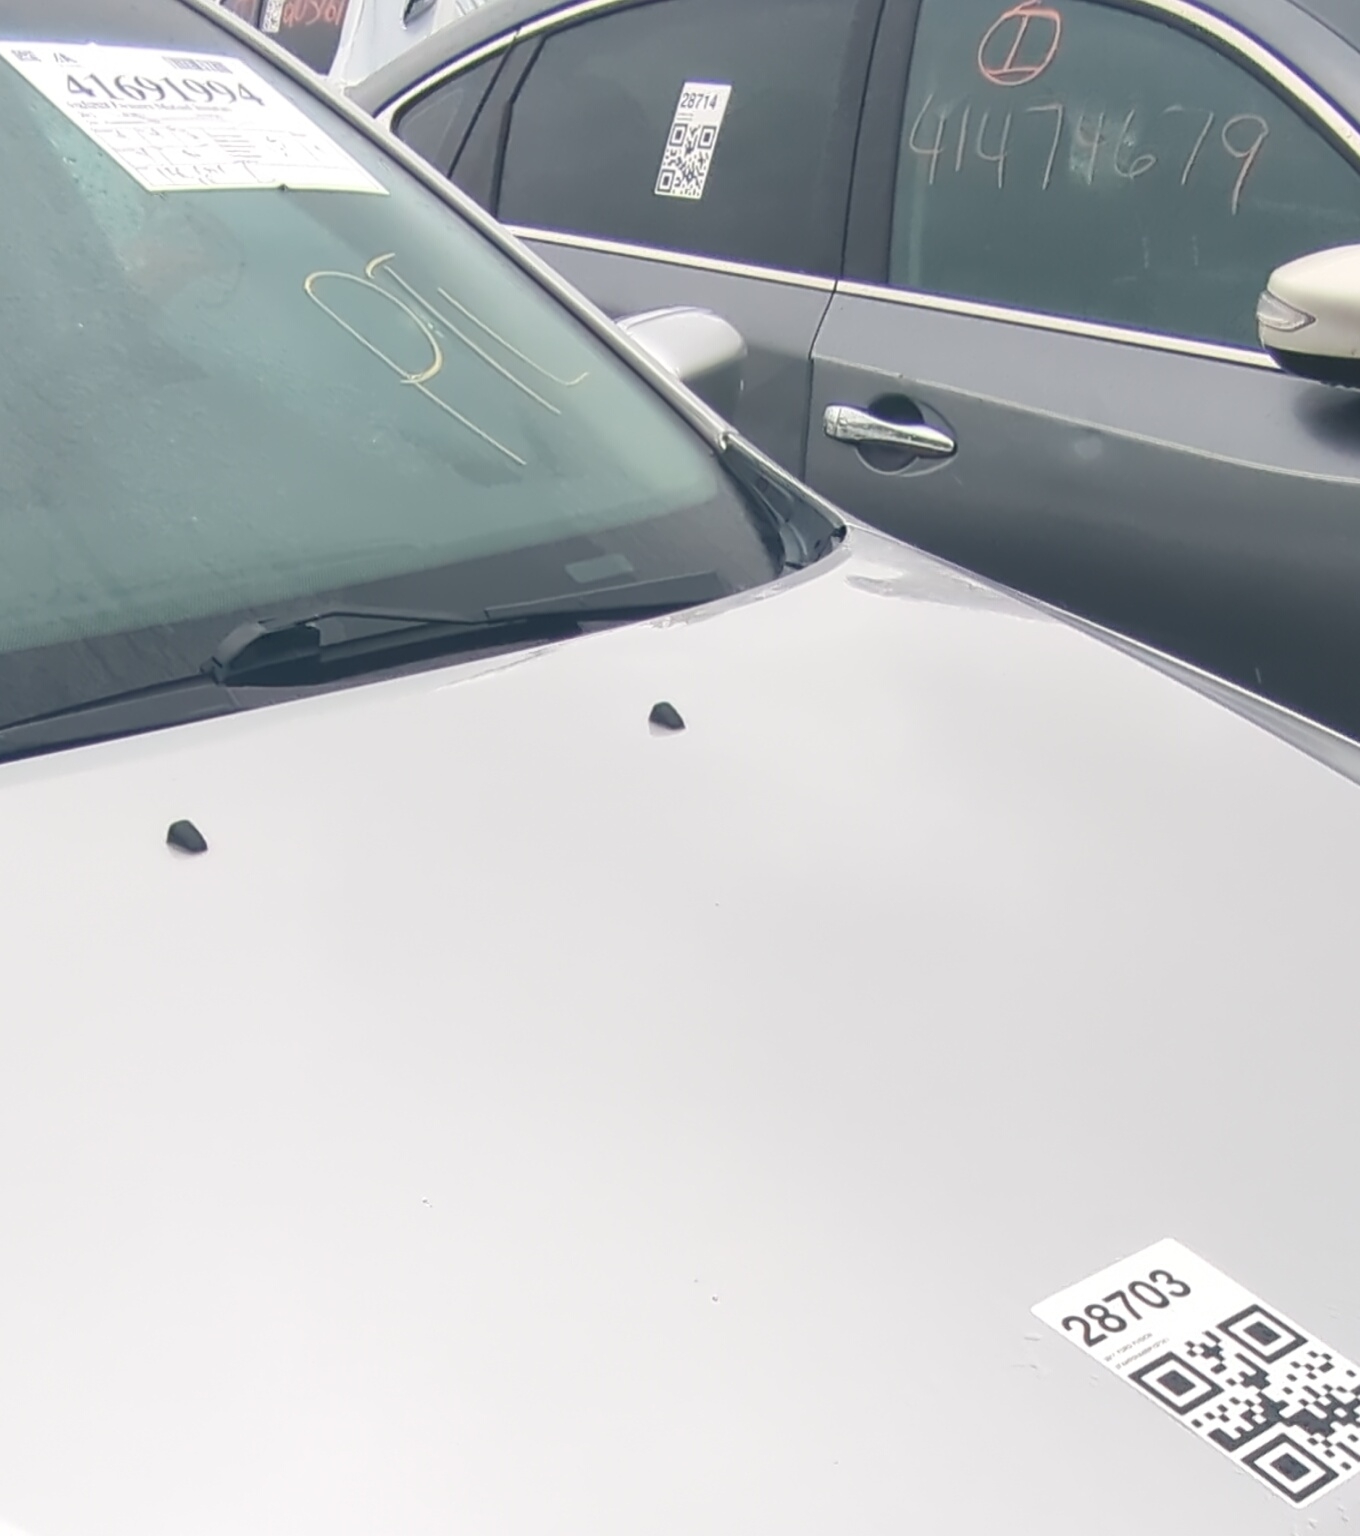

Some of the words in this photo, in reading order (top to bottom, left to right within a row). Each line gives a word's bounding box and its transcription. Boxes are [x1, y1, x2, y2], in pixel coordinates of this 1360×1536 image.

[67, 73, 266, 107] 41691994
[680, 92, 718, 110] 28714
[909, 94, 1270, 216] 41474679
[1061, 1269, 1192, 1348] 28703
